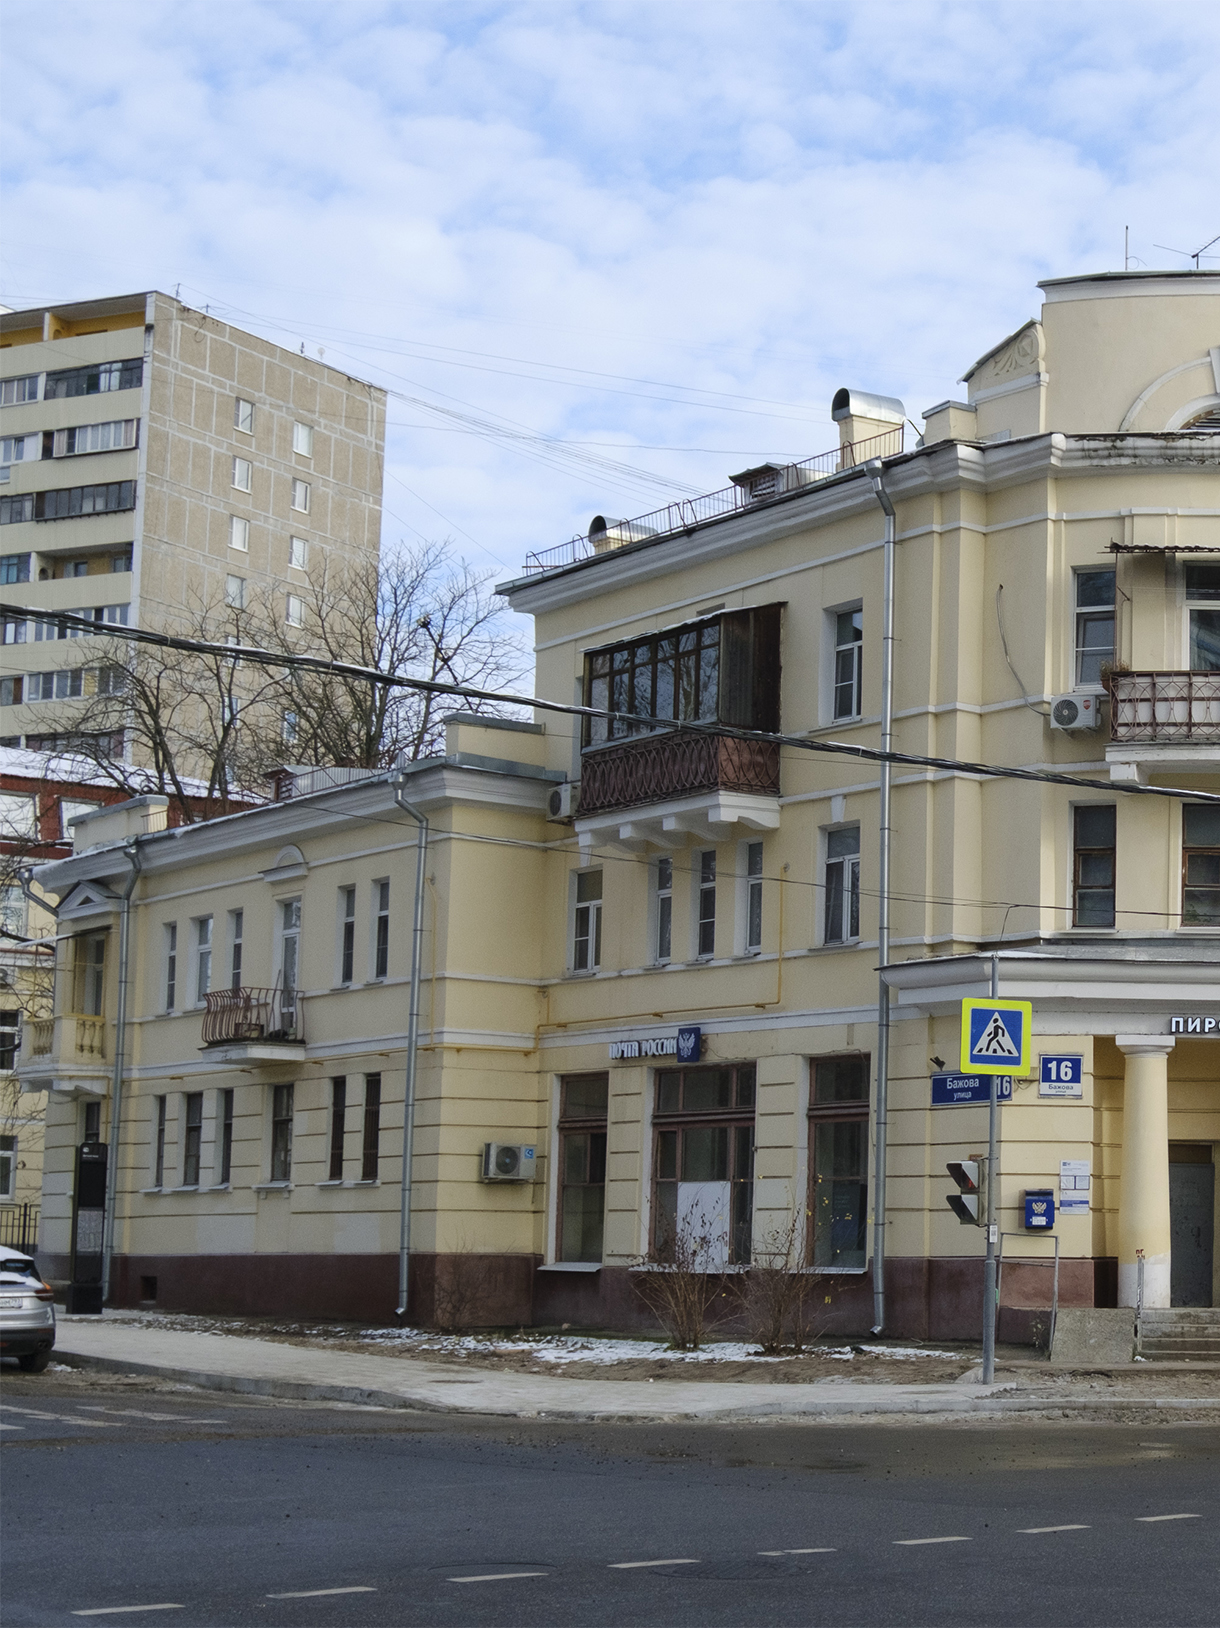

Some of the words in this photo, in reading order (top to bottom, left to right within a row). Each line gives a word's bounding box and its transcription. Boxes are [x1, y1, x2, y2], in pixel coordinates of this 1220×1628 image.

[609, 1041, 639, 1058] ПОЧТА
[641, 1038, 677, 1056] РОССИИ
[1047, 1061, 1073, 1081] 16
[946, 1077, 979, 1089] Бажова
[996, 1076, 1011, 1096] 16
[953, 1090, 972, 1101] улица
